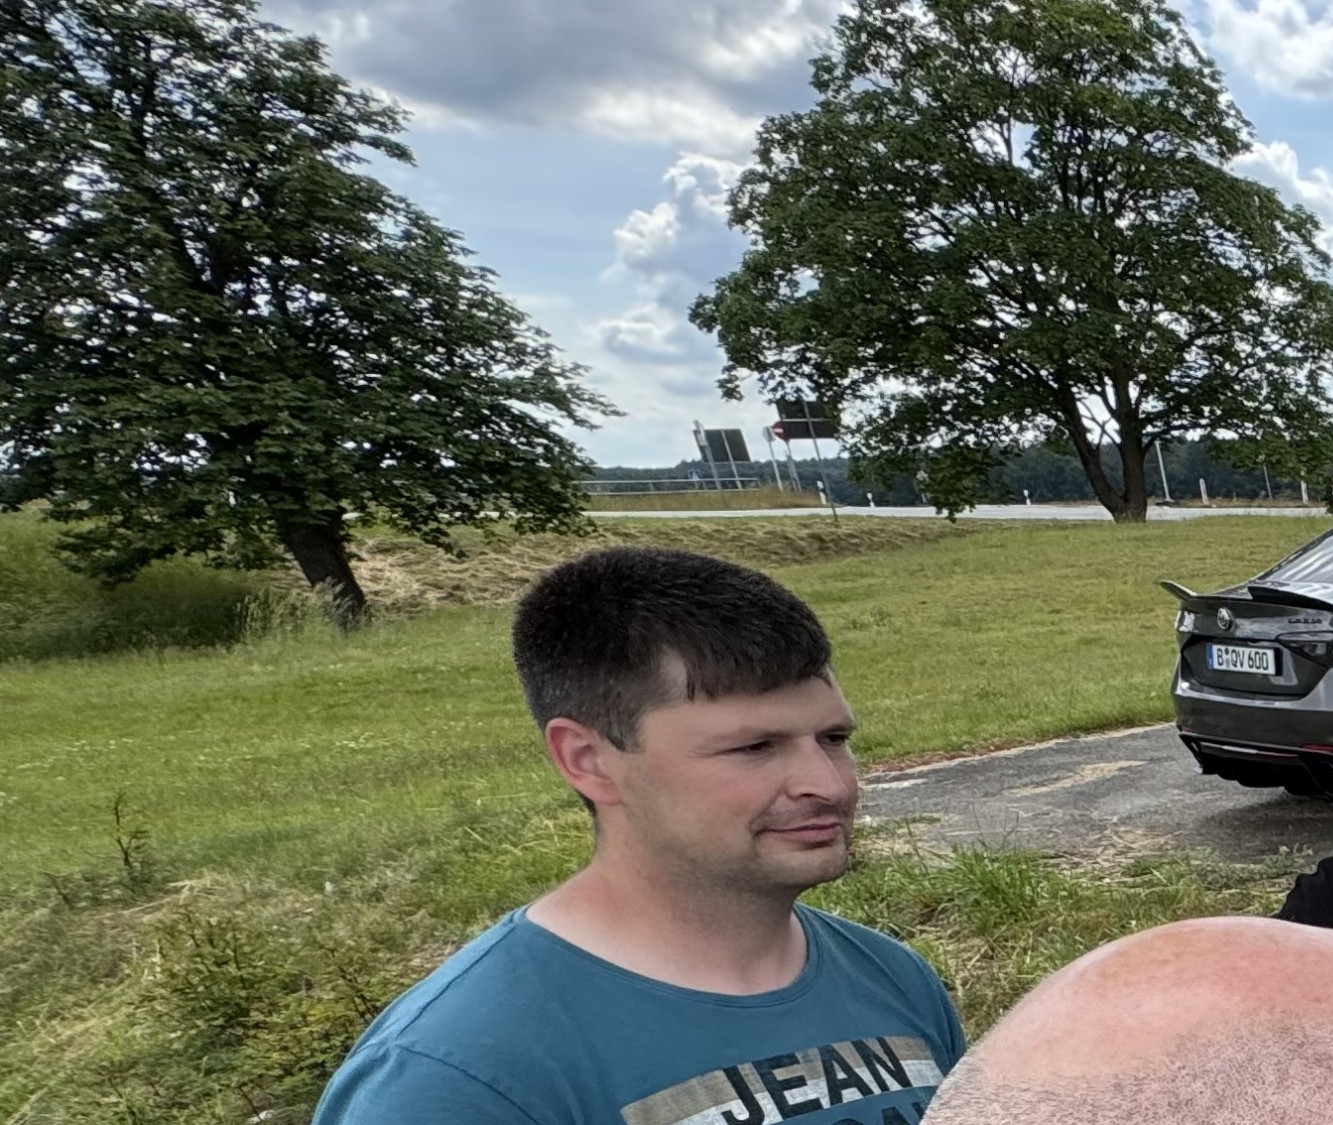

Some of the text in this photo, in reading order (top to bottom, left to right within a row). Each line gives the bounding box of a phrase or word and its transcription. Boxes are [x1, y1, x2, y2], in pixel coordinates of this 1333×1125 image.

[1216, 648, 1269, 671] B QV 600
